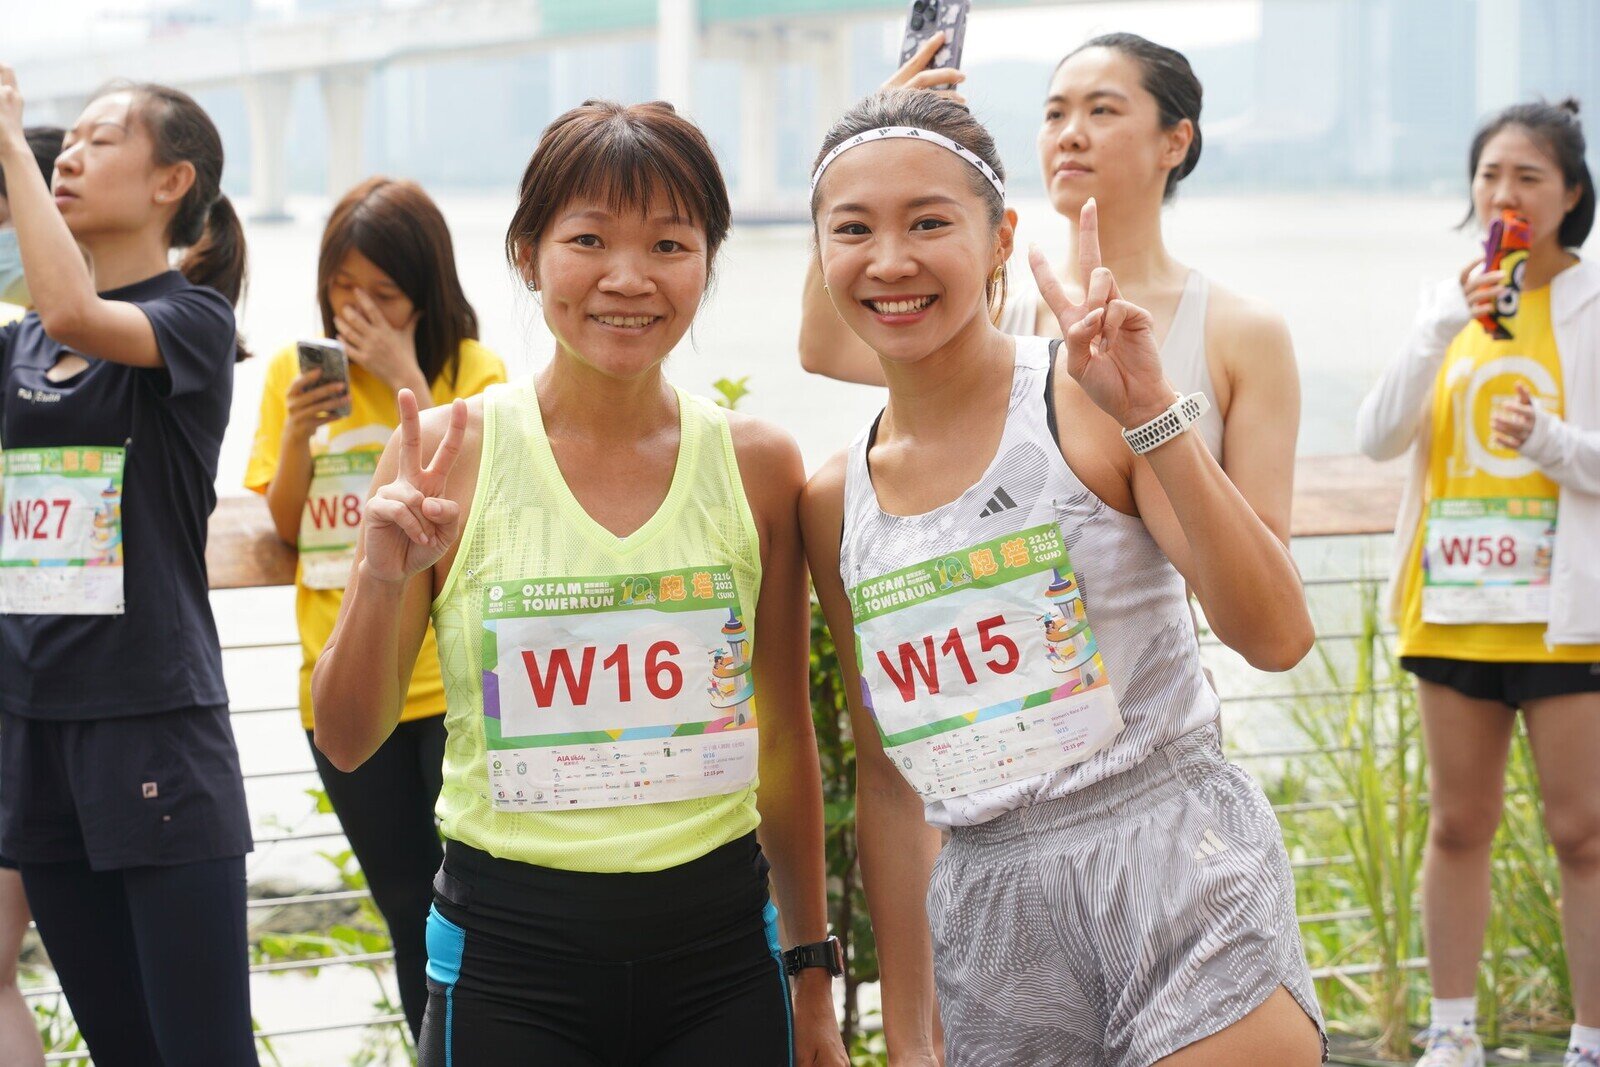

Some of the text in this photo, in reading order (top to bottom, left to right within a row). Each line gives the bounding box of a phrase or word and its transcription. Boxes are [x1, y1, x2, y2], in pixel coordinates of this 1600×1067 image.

[10, 499, 72, 540] W27
[1031, 540, 1059, 554] 2023
[1035, 550, 1061, 563] (SUN)
[1440, 536, 1517, 567] W58
[522, 582, 582, 597] OXFAM
[715, 582, 733, 590] 2023
[717, 591, 735, 600] (SUN)
[862, 575, 906, 599] OXFAM
[522, 595, 614, 612] TOWERRUN
[865, 581, 936, 614] TOWERRUN
[876, 614, 1020, 703] W15
[521, 640, 683, 708] W16
